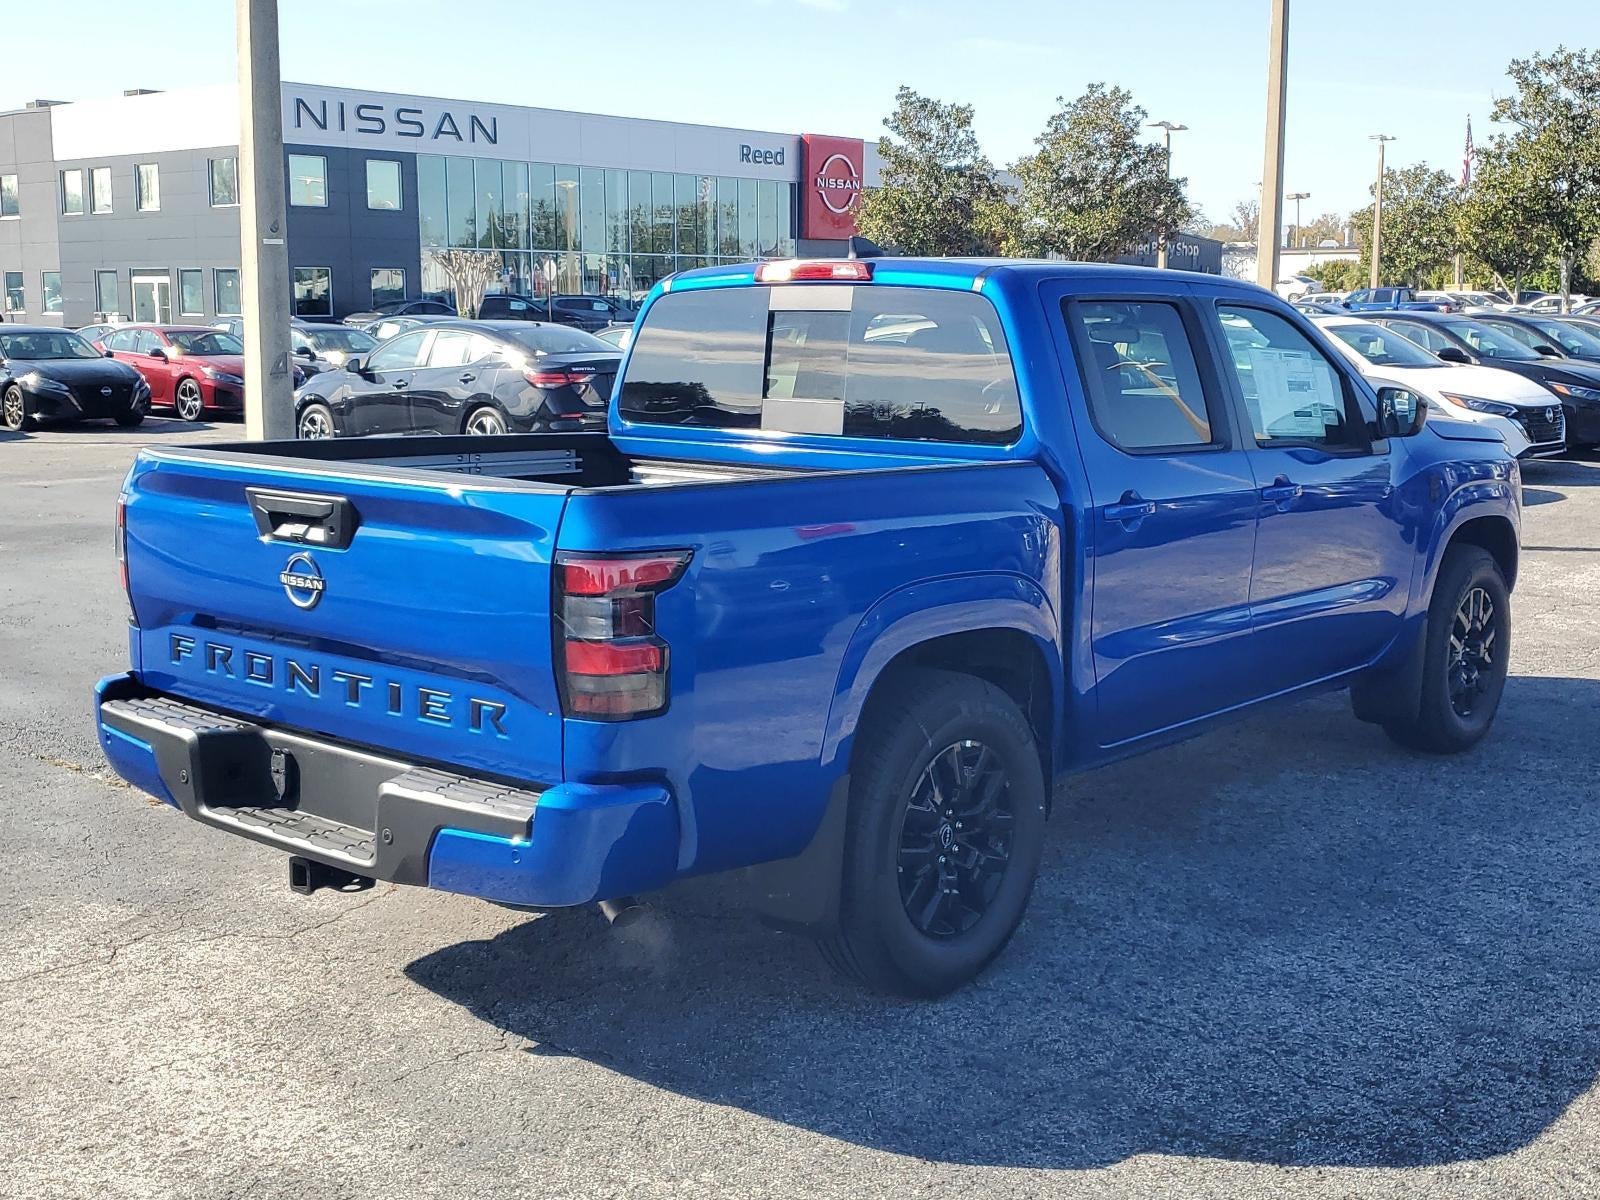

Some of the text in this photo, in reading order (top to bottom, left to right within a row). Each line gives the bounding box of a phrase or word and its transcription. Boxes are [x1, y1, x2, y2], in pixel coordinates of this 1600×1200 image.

[294, 97, 498, 145] NISSAN
[740, 144, 785, 166] Reed
[817, 177, 860, 190] NISSAN
[1176, 242, 1199, 256] Shop
[281, 574, 323, 590] NISSAN
[170, 634, 510, 739] FRONTIER
